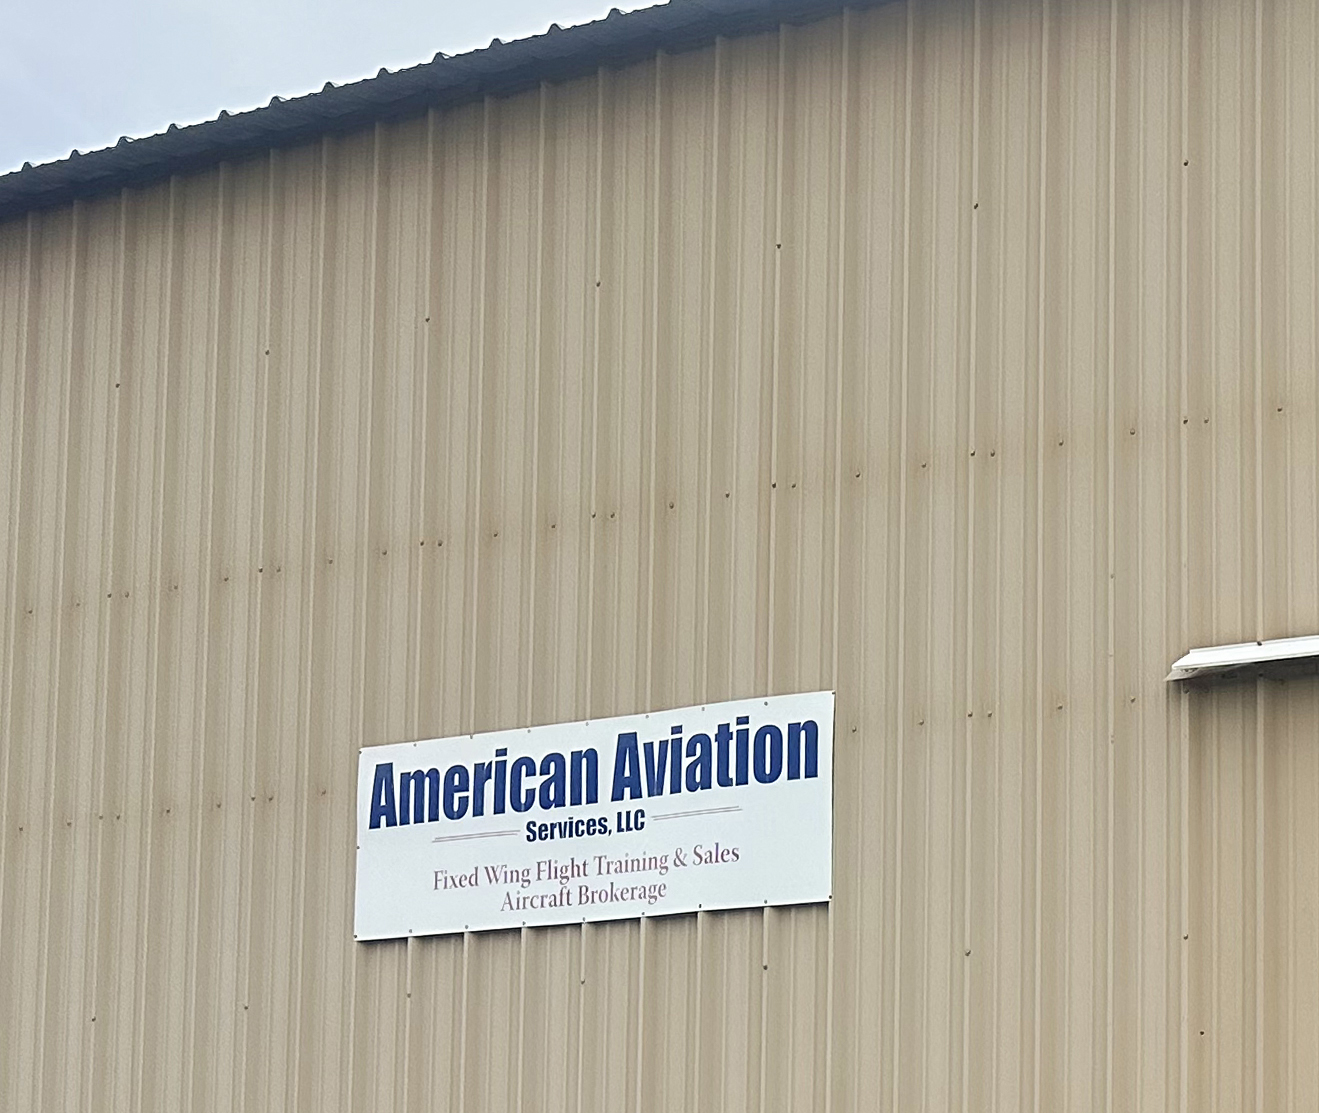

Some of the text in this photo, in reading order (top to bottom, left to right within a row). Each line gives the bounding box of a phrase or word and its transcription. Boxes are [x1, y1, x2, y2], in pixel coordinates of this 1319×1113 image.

[368, 713, 820, 831] American Aviation
[525, 808, 646, 843] Services, LLC
[432, 842, 741, 892] Fixed Wing Flight Training & Sales
[500, 878, 668, 913] Aircraft Brokerage
